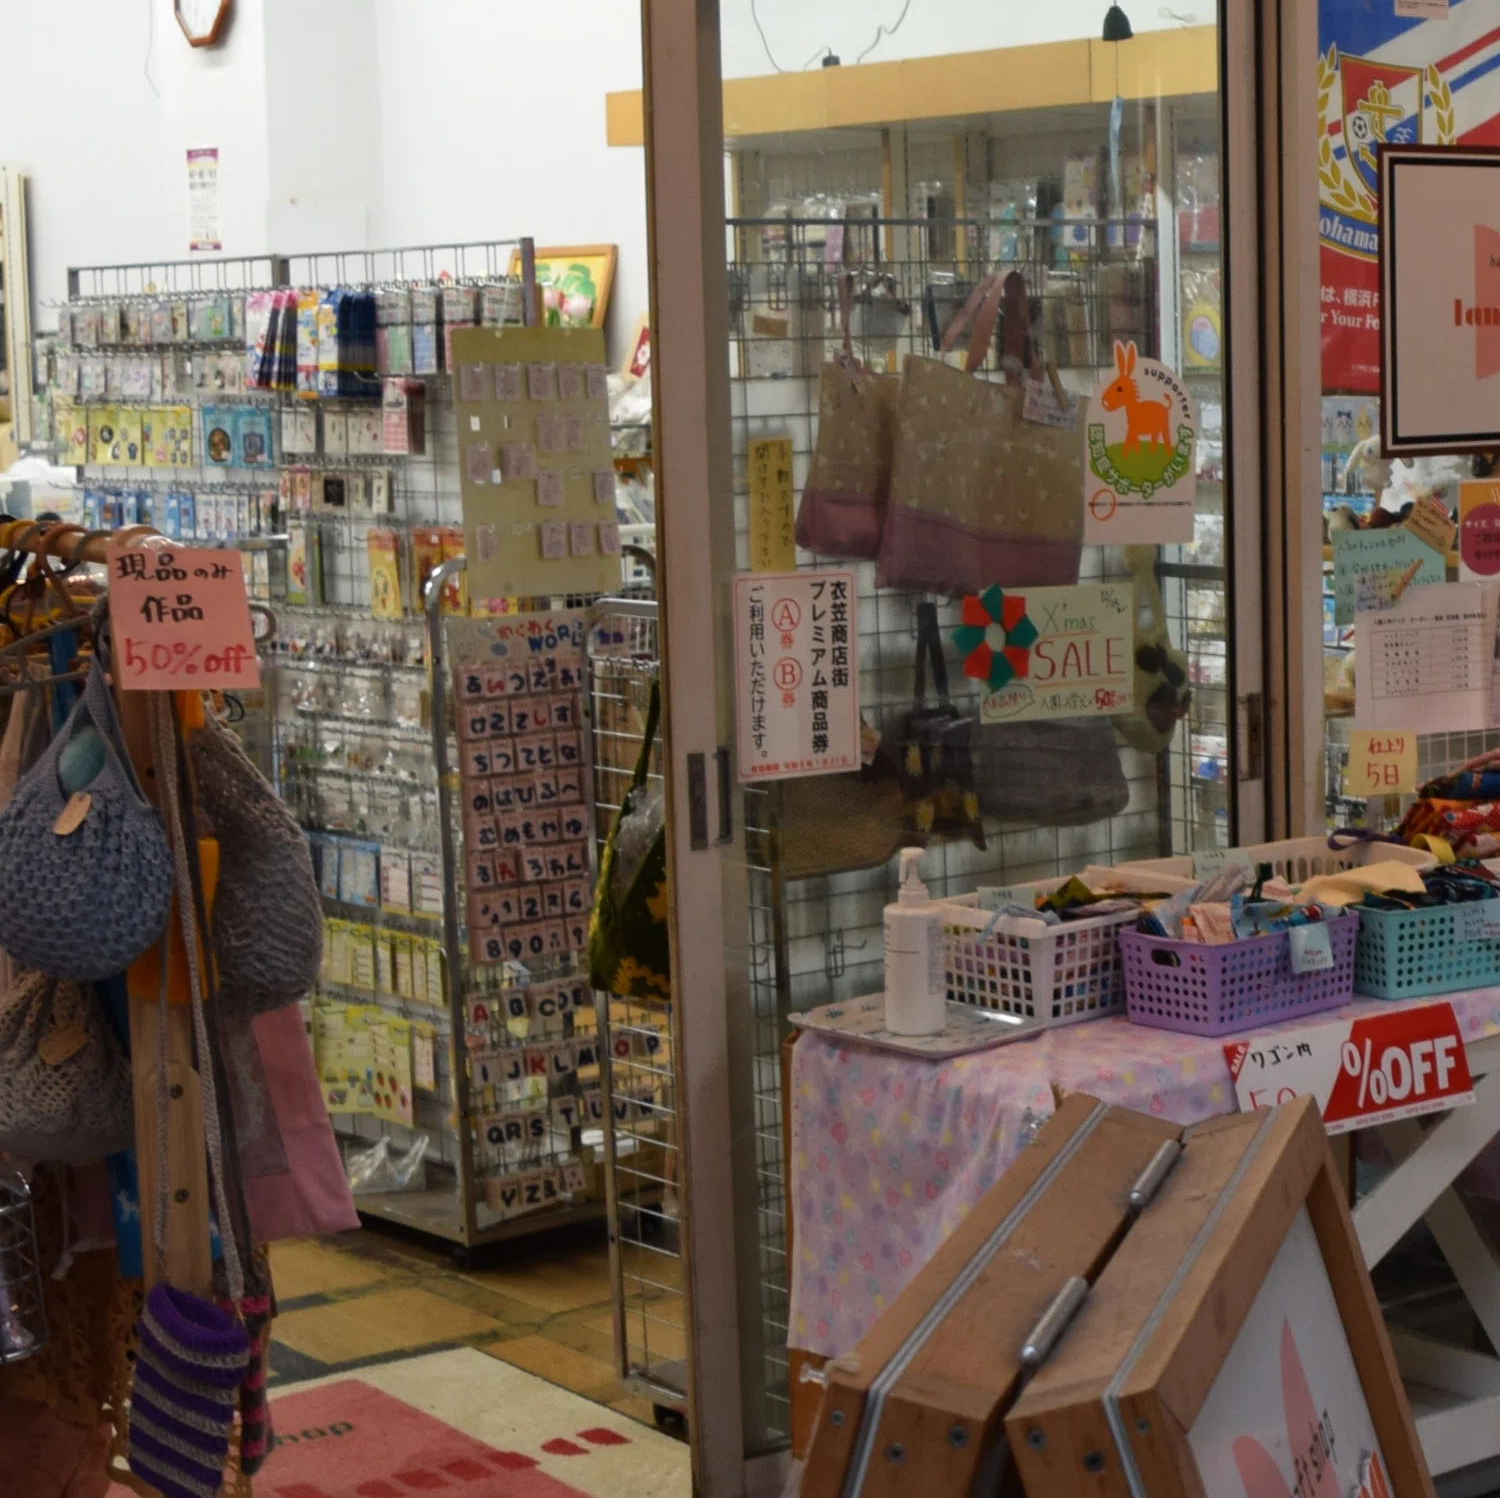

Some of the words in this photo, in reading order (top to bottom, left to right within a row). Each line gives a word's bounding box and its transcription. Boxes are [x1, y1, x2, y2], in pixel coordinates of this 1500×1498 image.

[1330, 309, 1363, 329] Your
[1143, 366, 1192, 420] supporter
[115, 552, 233, 582] 現品のみ
[140, 594, 203, 624] 作品
[830, 580, 849, 688] 衣笠商店街
[749, 585, 768, 759] ご利用いただけます。
[810, 580, 830, 754] プレミアム商品券
[1033, 637, 1127, 681] SALE
[1366, 763, 1400, 787] 5日
[1230, 1044, 1248, 1075] SALE
[1250, 1042, 1313, 1071] ワゴン内
[1340, 1034, 1458, 1109] %OFF
[1308, 1408, 1338, 1483] shop
